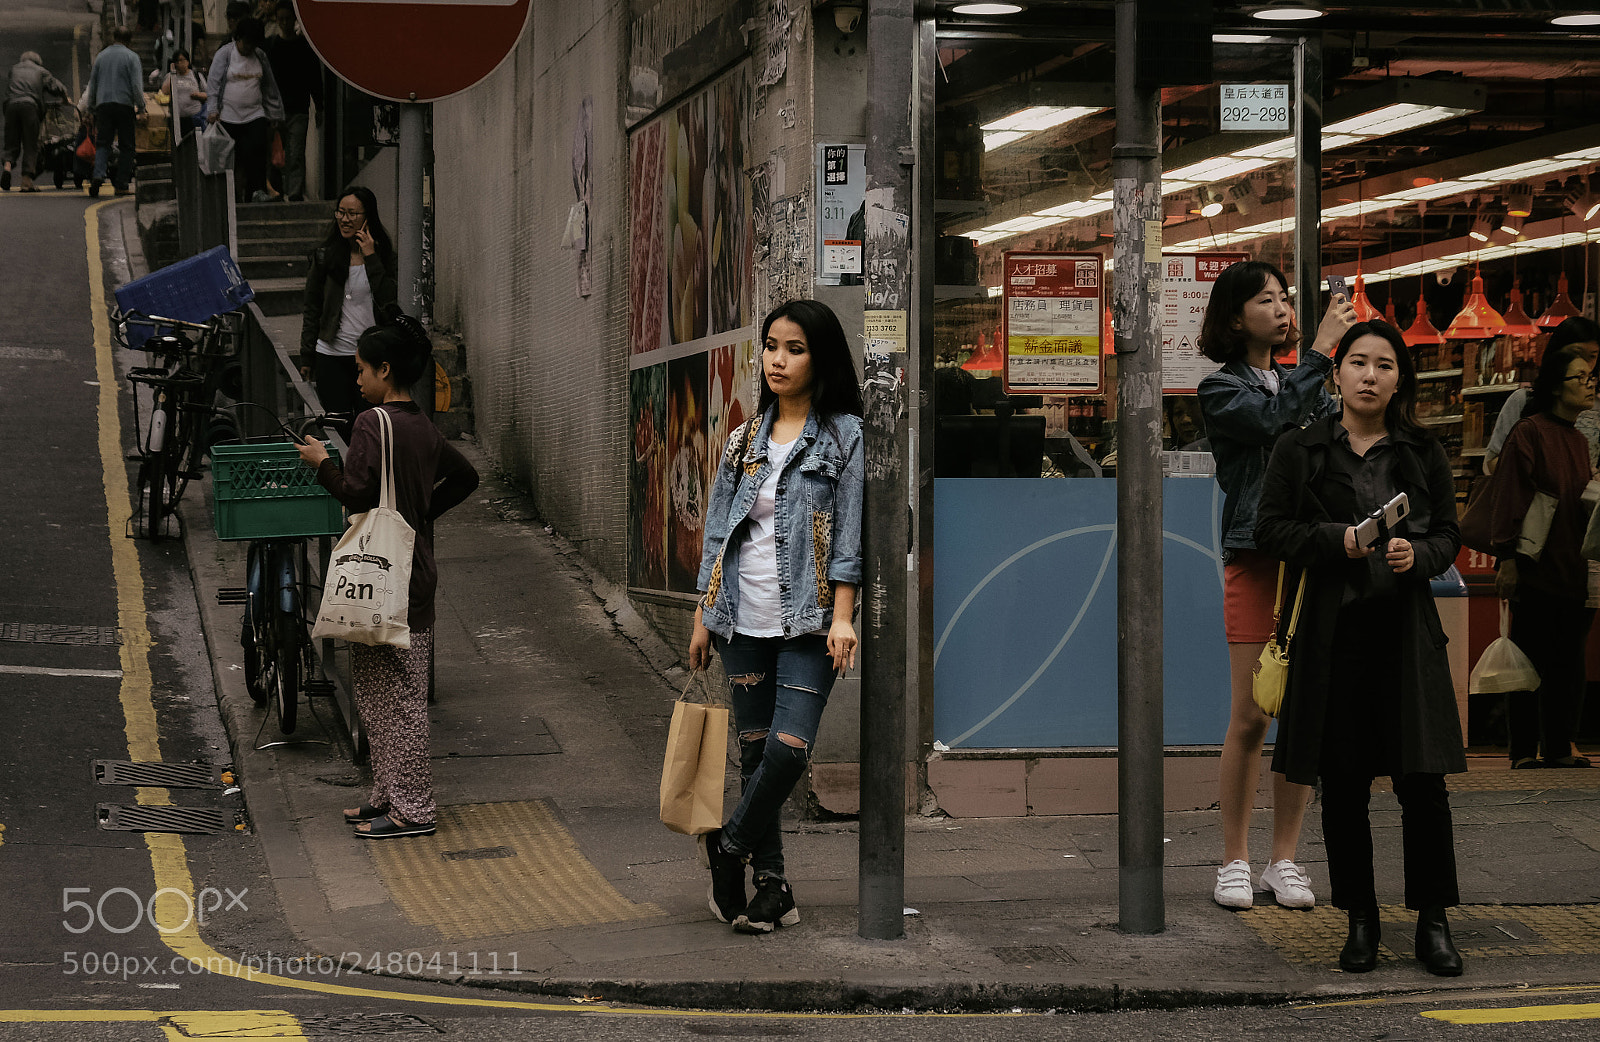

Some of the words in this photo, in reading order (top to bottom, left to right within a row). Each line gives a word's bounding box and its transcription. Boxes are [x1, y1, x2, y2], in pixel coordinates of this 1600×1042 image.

[1223, 87, 1285, 99] 皇后大道西
[1222, 106, 1287, 122] 292-298
[827, 148, 846, 159] 你的
[824, 206, 845, 220] 3.11
[1011, 263, 1058, 276] 人才招募
[1198, 260, 1239, 271] 歡迎光
[1182, 291, 1202, 299] 8:00
[1012, 300, 1048, 311] 店務員
[1059, 300, 1094, 311] 理貨員
[1024, 339, 1083, 354] 薪金面議
[335, 575, 374, 600] Pan
